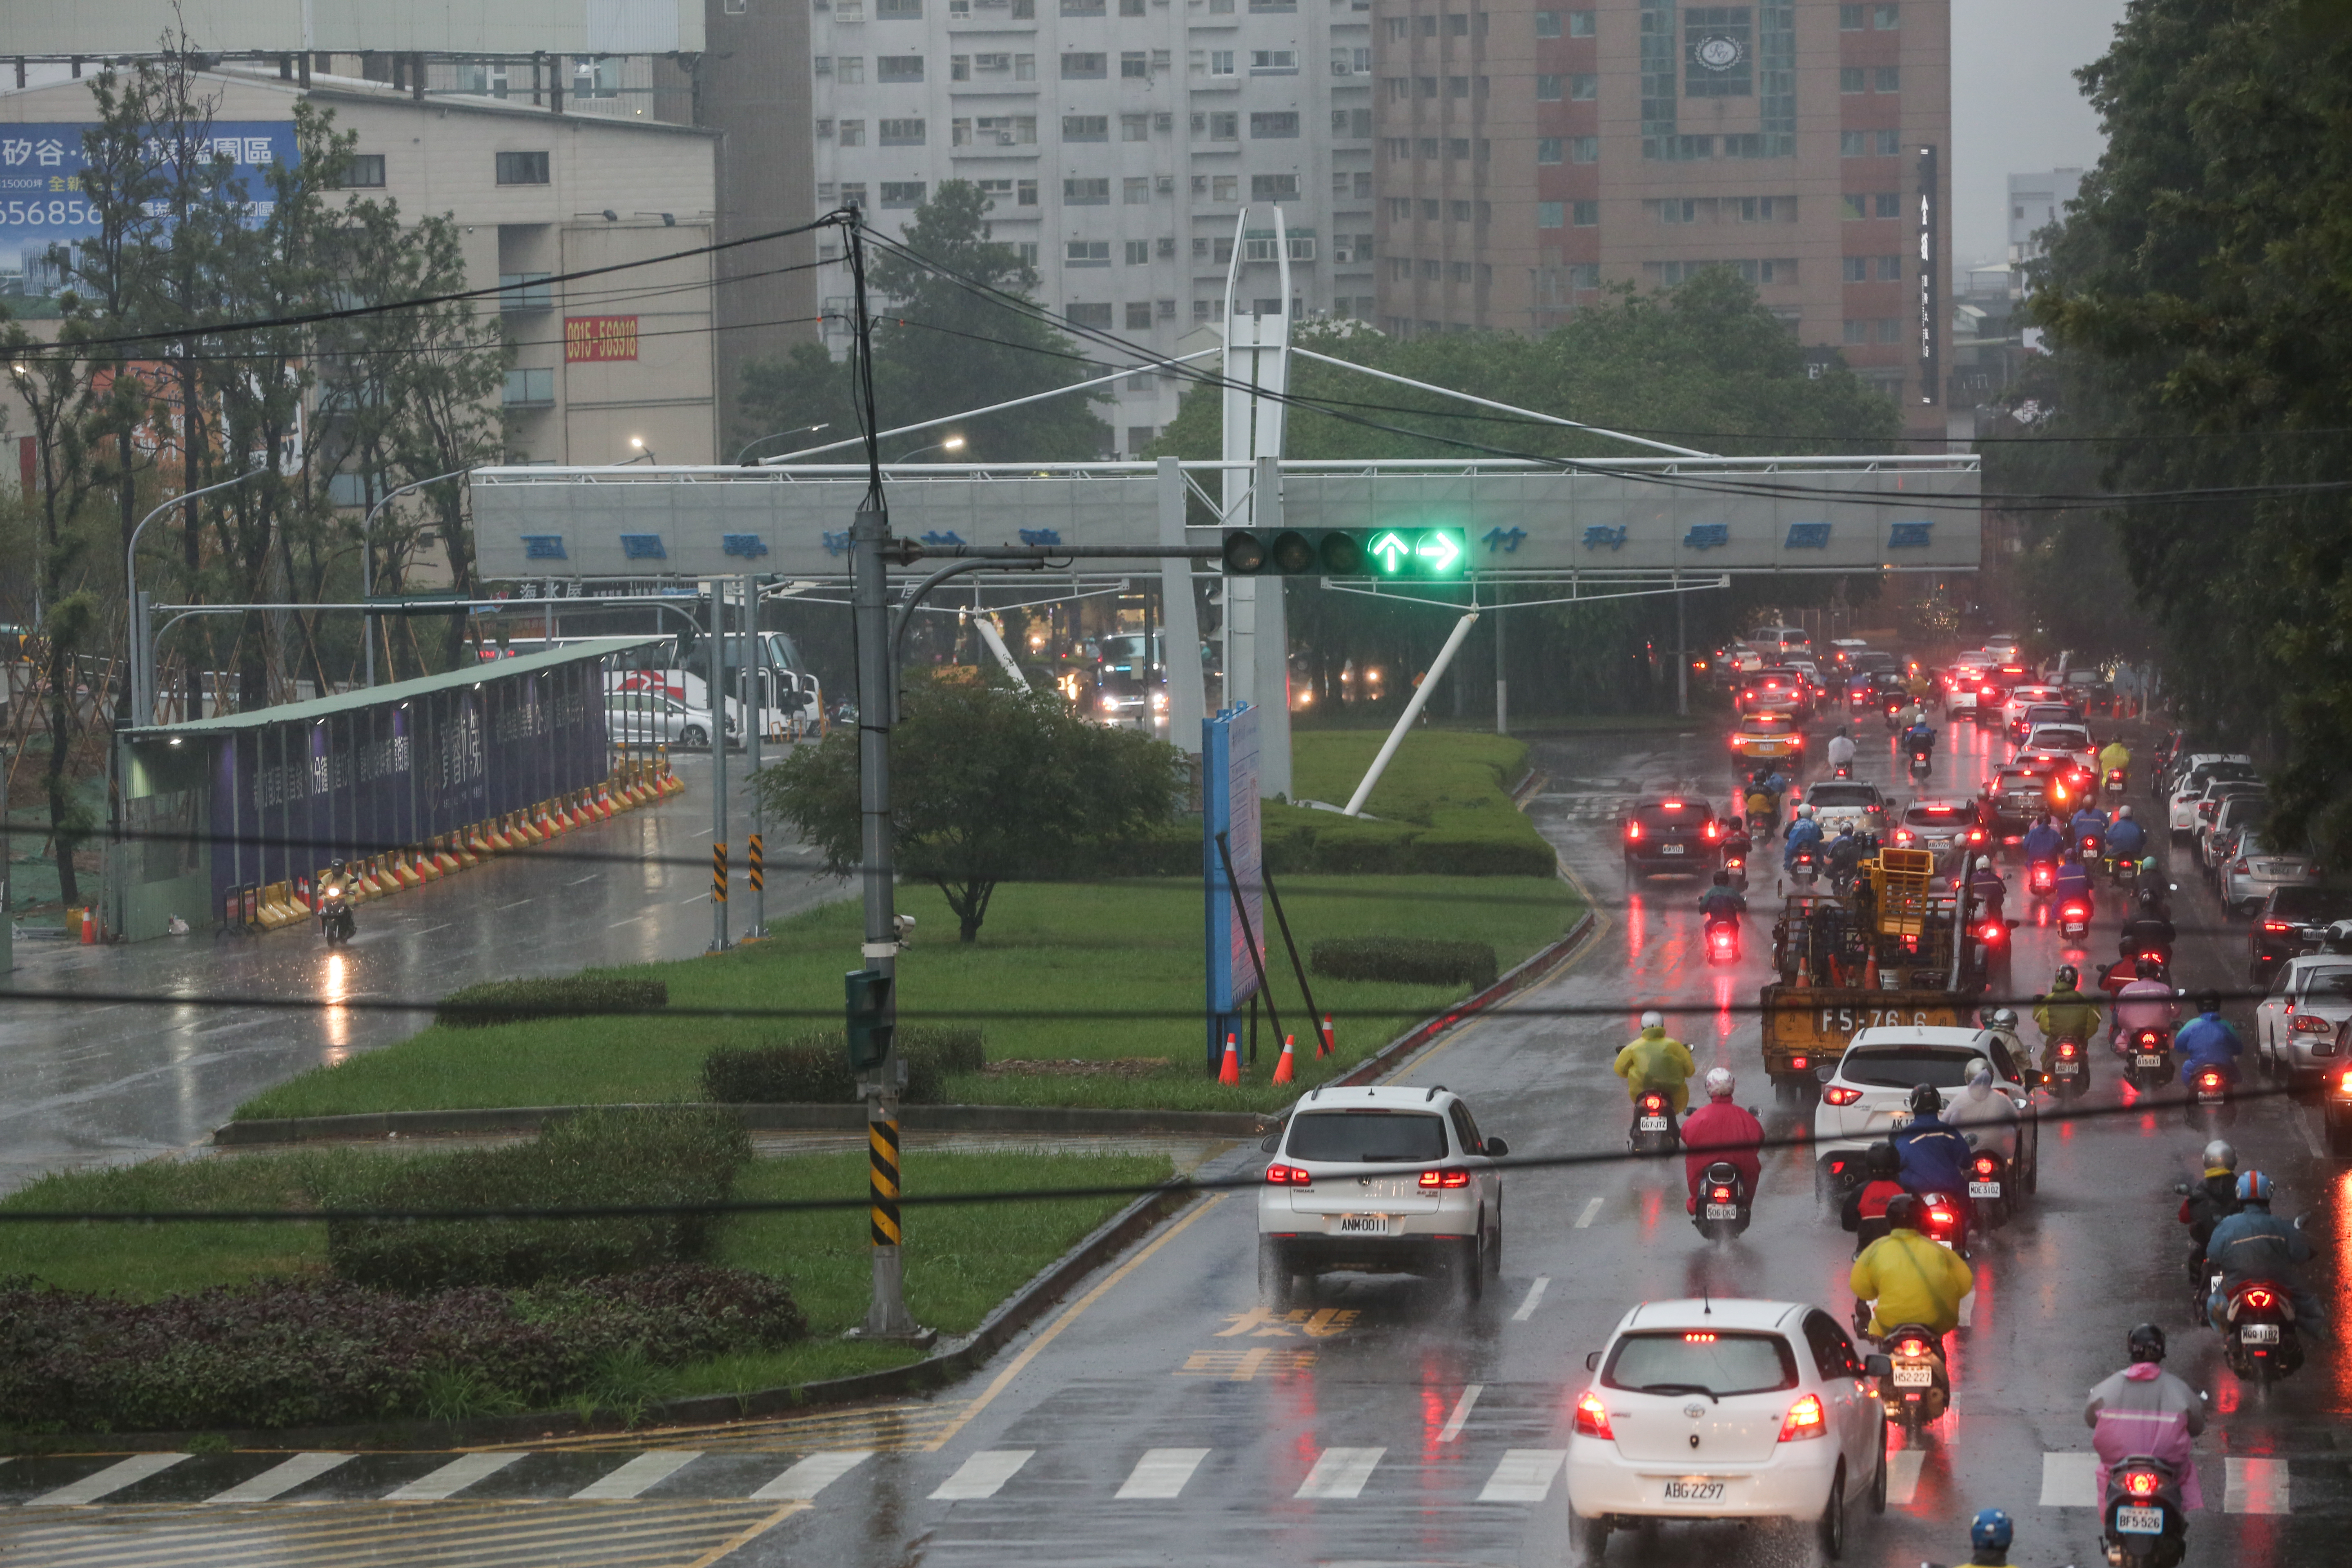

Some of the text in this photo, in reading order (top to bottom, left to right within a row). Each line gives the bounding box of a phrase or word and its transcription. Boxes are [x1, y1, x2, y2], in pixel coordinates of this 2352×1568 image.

[568, 320, 636, 359] 0915-569918
[1341, 1219, 1385, 1231] ANM-0011
[1665, 1482, 1724, 1499] ABG-2297
[2120, 1515, 2160, 1528] BF5-526
